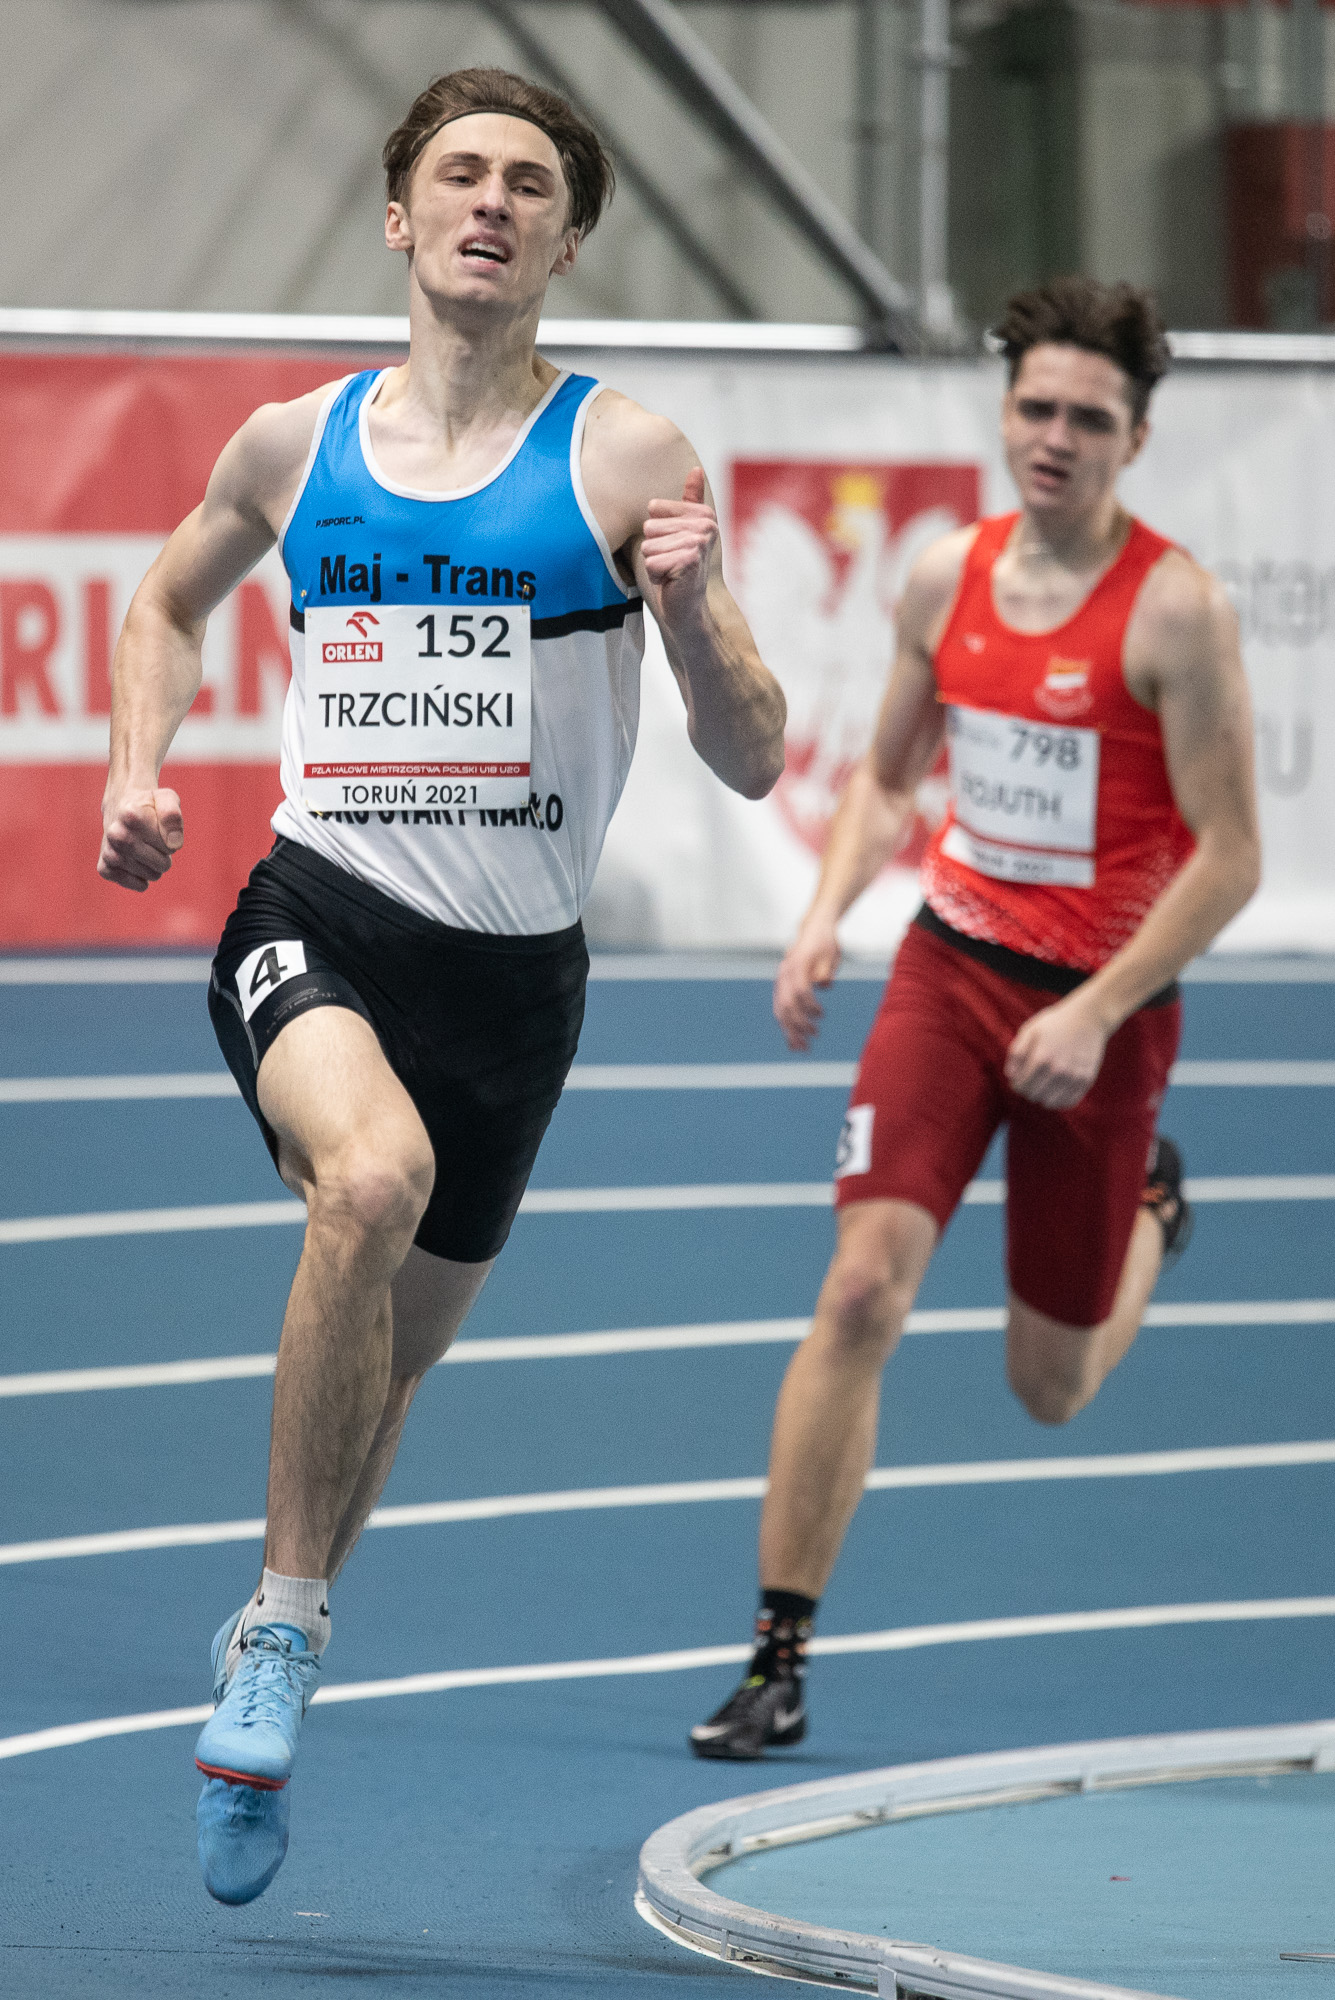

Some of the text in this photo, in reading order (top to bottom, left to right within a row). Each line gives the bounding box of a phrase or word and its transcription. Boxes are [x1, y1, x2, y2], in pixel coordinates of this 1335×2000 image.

[320, 553, 381, 602] Maj
[423, 554, 536, 601] Trans
[324, 644, 379, 661] ORLEN
[416, 614, 511, 658] 152
[318, 684, 513, 728] TRZCIŃSKI
[1009, 721, 1081, 771] 798
[311, 766, 331, 775] PZLA
[332, 766, 368, 774] HALOWE
[369, 765, 440, 774] MISTRZOSTWA
[442, 765, 478, 774] POLSKI
[342, 779, 477, 804] TORUŃ 2021
[249, 945, 288, 998] 4
